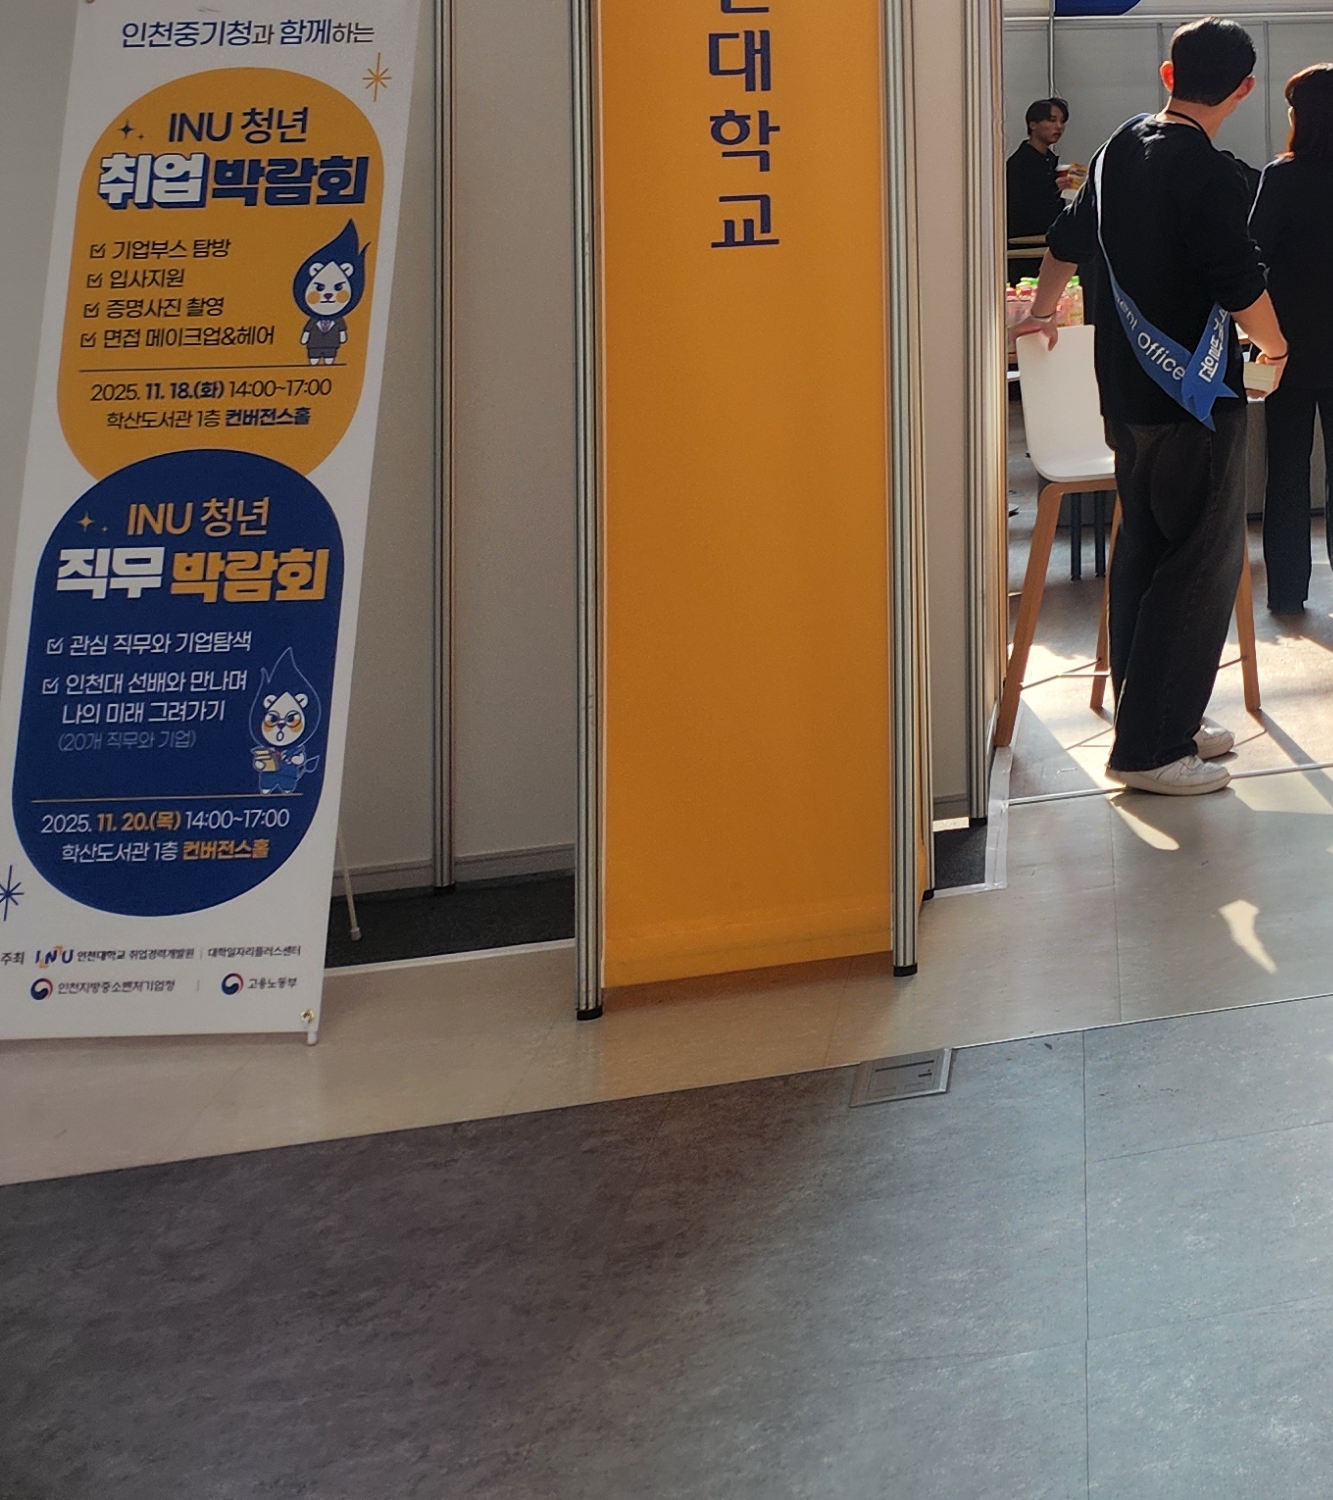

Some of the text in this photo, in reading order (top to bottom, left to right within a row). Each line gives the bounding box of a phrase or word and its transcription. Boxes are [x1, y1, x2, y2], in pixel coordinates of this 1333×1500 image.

[121, 19, 375, 49] 인천중기청과 함께하는
[168, 108, 309, 144] INU 청년
[98, 152, 370, 210] 취업 박람회
[111, 238, 232, 260] 기업부스 탐방
[110, 269, 186, 289] 입사지원
[105, 296, 225, 319] 증명사진 촬영
[103, 325, 275, 349] 면접 메이크업&헤어
[1138, 332, 1185, 381] Office
[90, 378, 332, 402] 2025. 11. 18.(화) 14:00~17:00
[106, 406, 312, 430] 학산도서관 1층 컨버전스홀
[128, 498, 270, 538] INU 청년
[55, 546, 330, 603] 직무 박람회
[69, 631, 252, 656] 관심 직무와 기업탐색
[66, 670, 248, 695] 인천대 선배와 만나며
[62, 699, 226, 725] 나의 미래 그려가기
[58, 728, 197, 753] (20개 직무와 기업)
[40, 808, 290, 835] 2025. 11. 20.(목) 14:00~17:00
[62, 840, 270, 864] 학산도서관 1층 컨버전스홀
[2, 952, 24, 964] 주최
[77, 950, 126, 962] 인천대학교
[128, 948, 194, 960] 취업경력개발원
[248, 978, 297, 990] 고용노동부
